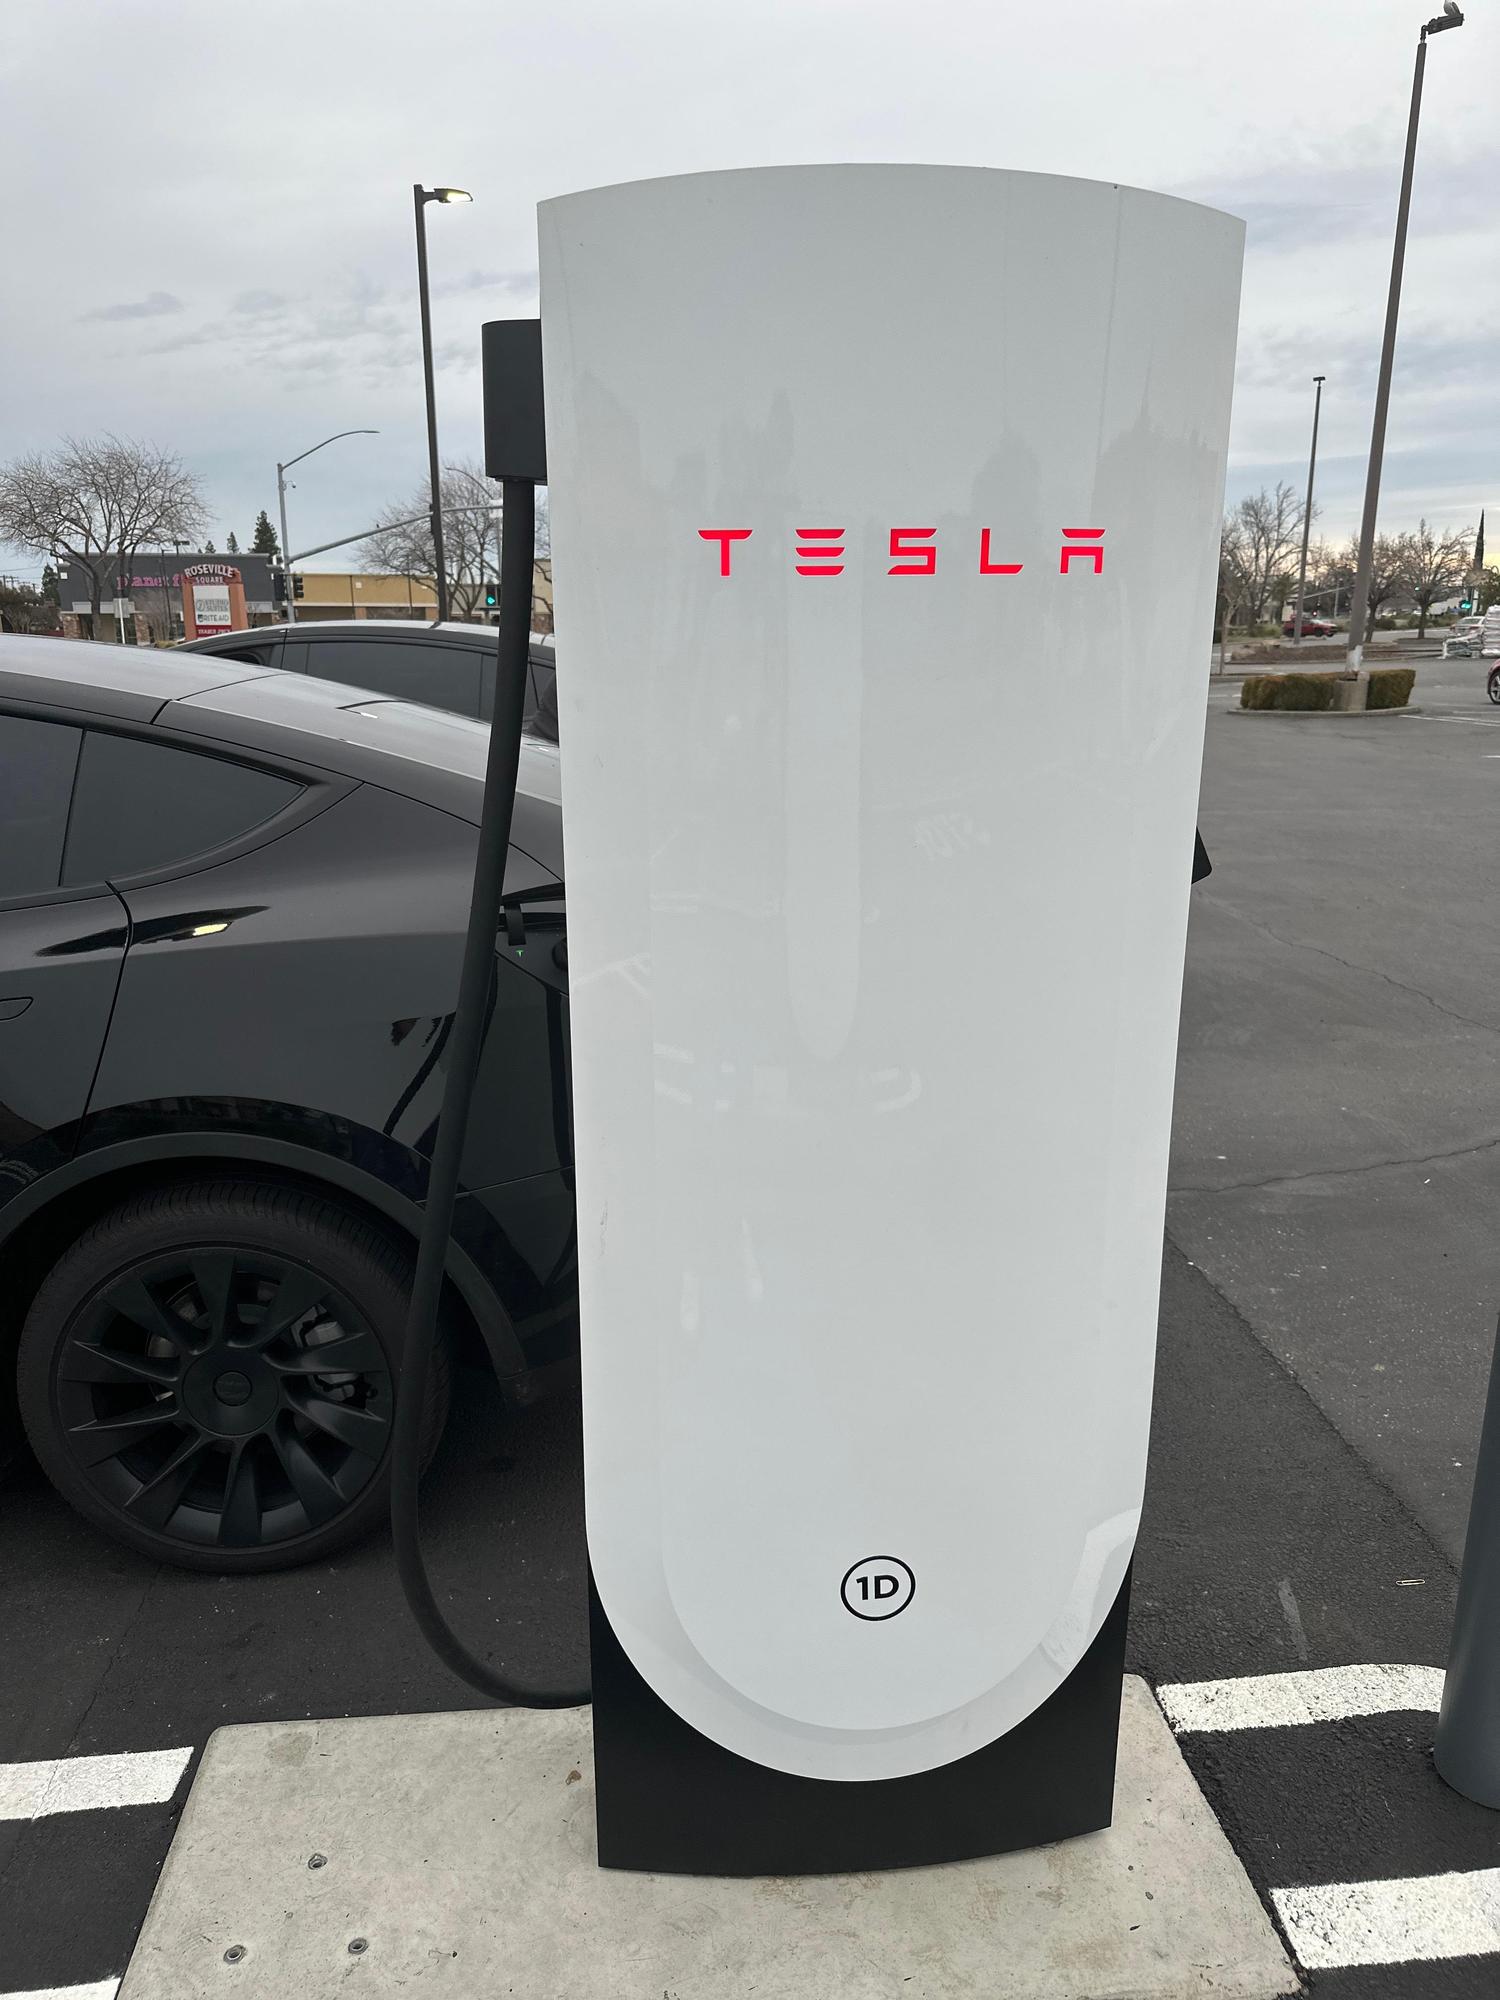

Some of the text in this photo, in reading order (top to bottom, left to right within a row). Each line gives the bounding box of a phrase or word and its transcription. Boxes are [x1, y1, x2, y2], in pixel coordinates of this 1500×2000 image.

[698, 528, 1106, 577] TESLA
[184, 563, 233, 578] ROSEVILLE
[195, 576, 224, 584] SQUARE
[203, 614, 230, 622] RITE AID
[856, 1575, 899, 1600] 1D
